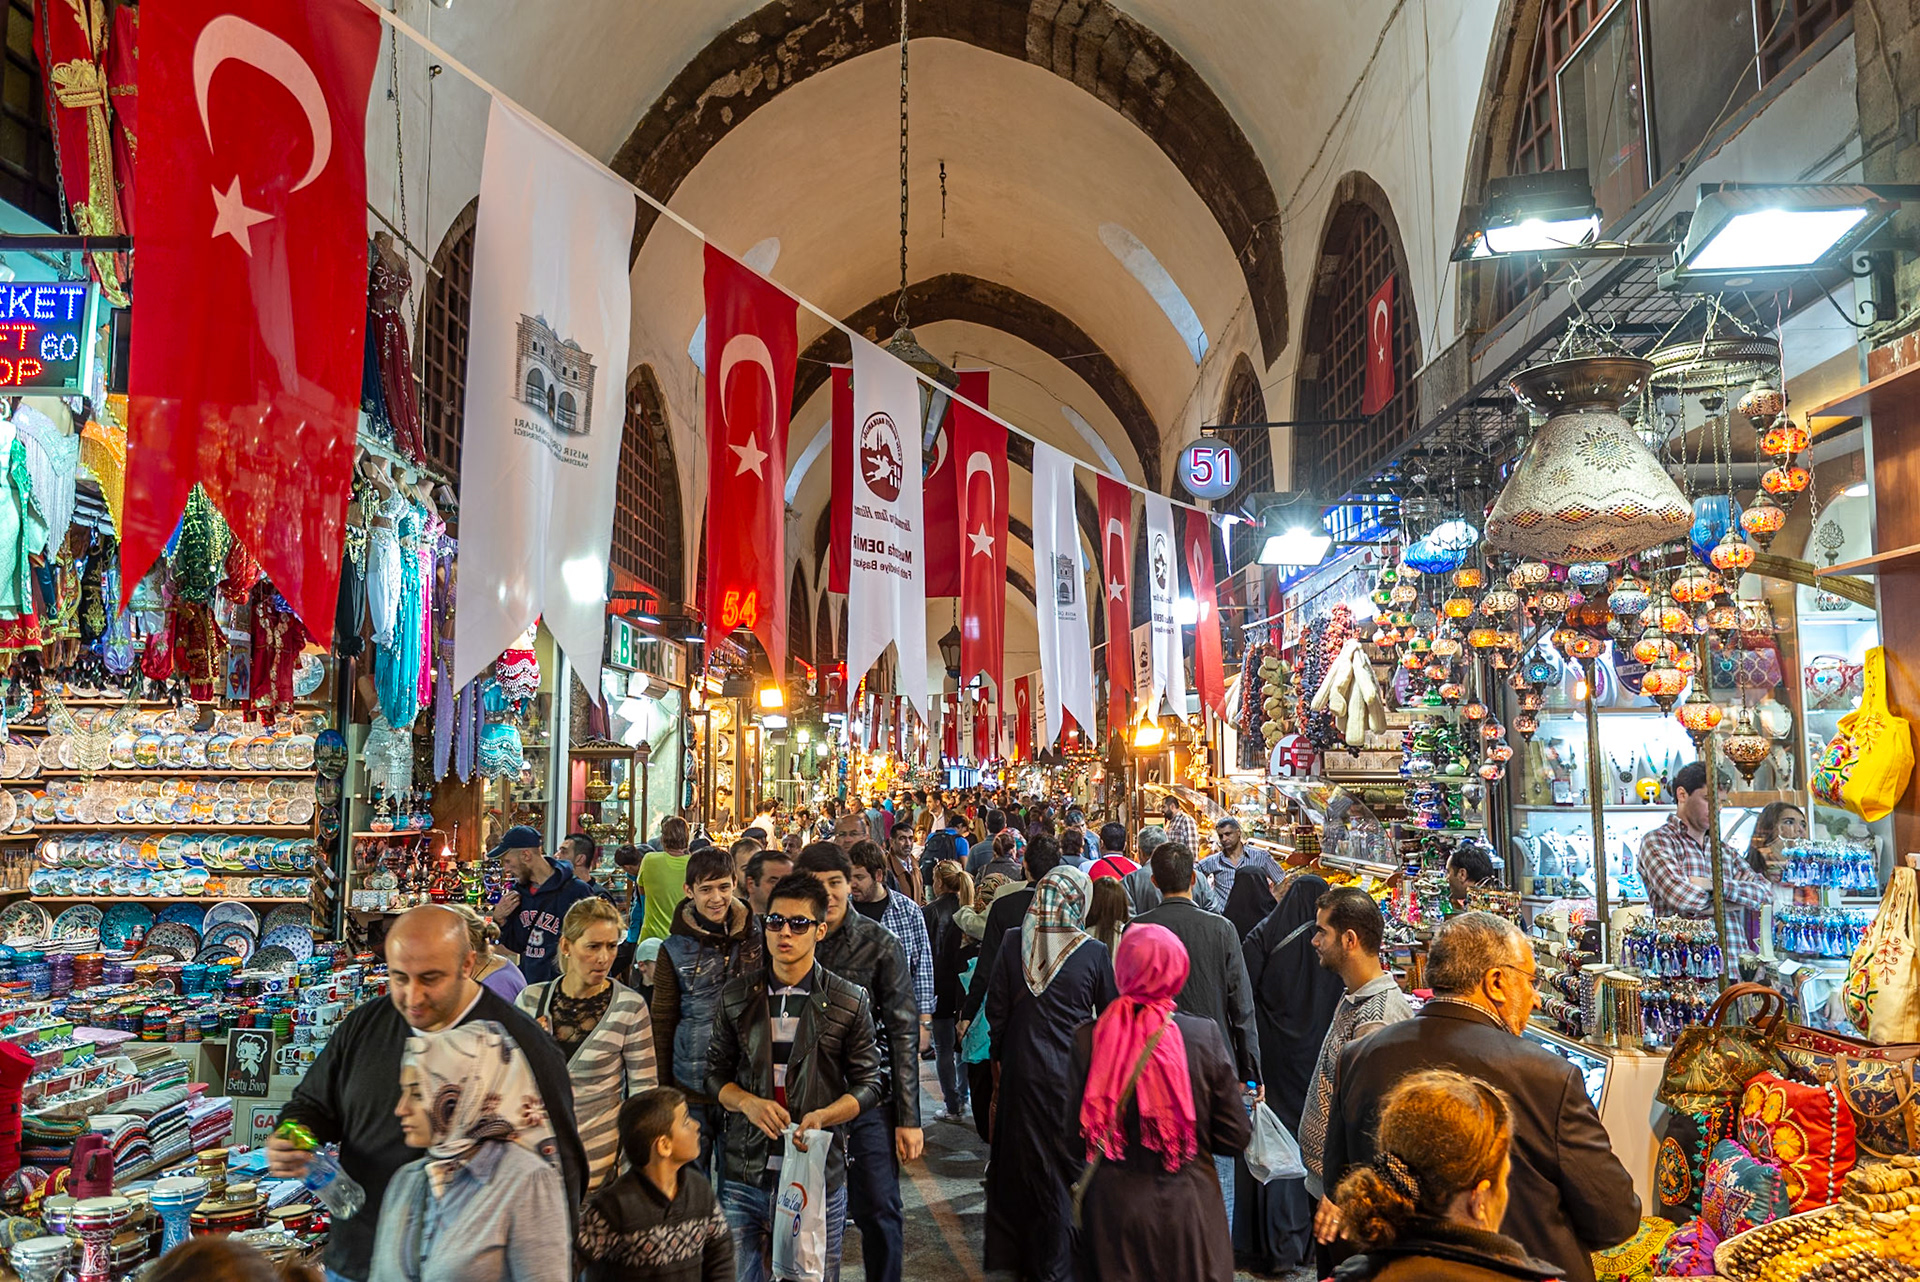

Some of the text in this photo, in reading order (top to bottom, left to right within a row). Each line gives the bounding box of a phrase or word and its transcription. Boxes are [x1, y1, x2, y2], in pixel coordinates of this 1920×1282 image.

[41, 333, 79, 361] 60
[1190, 447, 1232, 486] 51
[722, 590, 757, 628] 54
[620, 624, 684, 682] BEREKET
[227, 1077, 267, 1095] Betty Boop
[254, 1114, 279, 1128] GA
[253, 1133, 269, 1142] PAR
